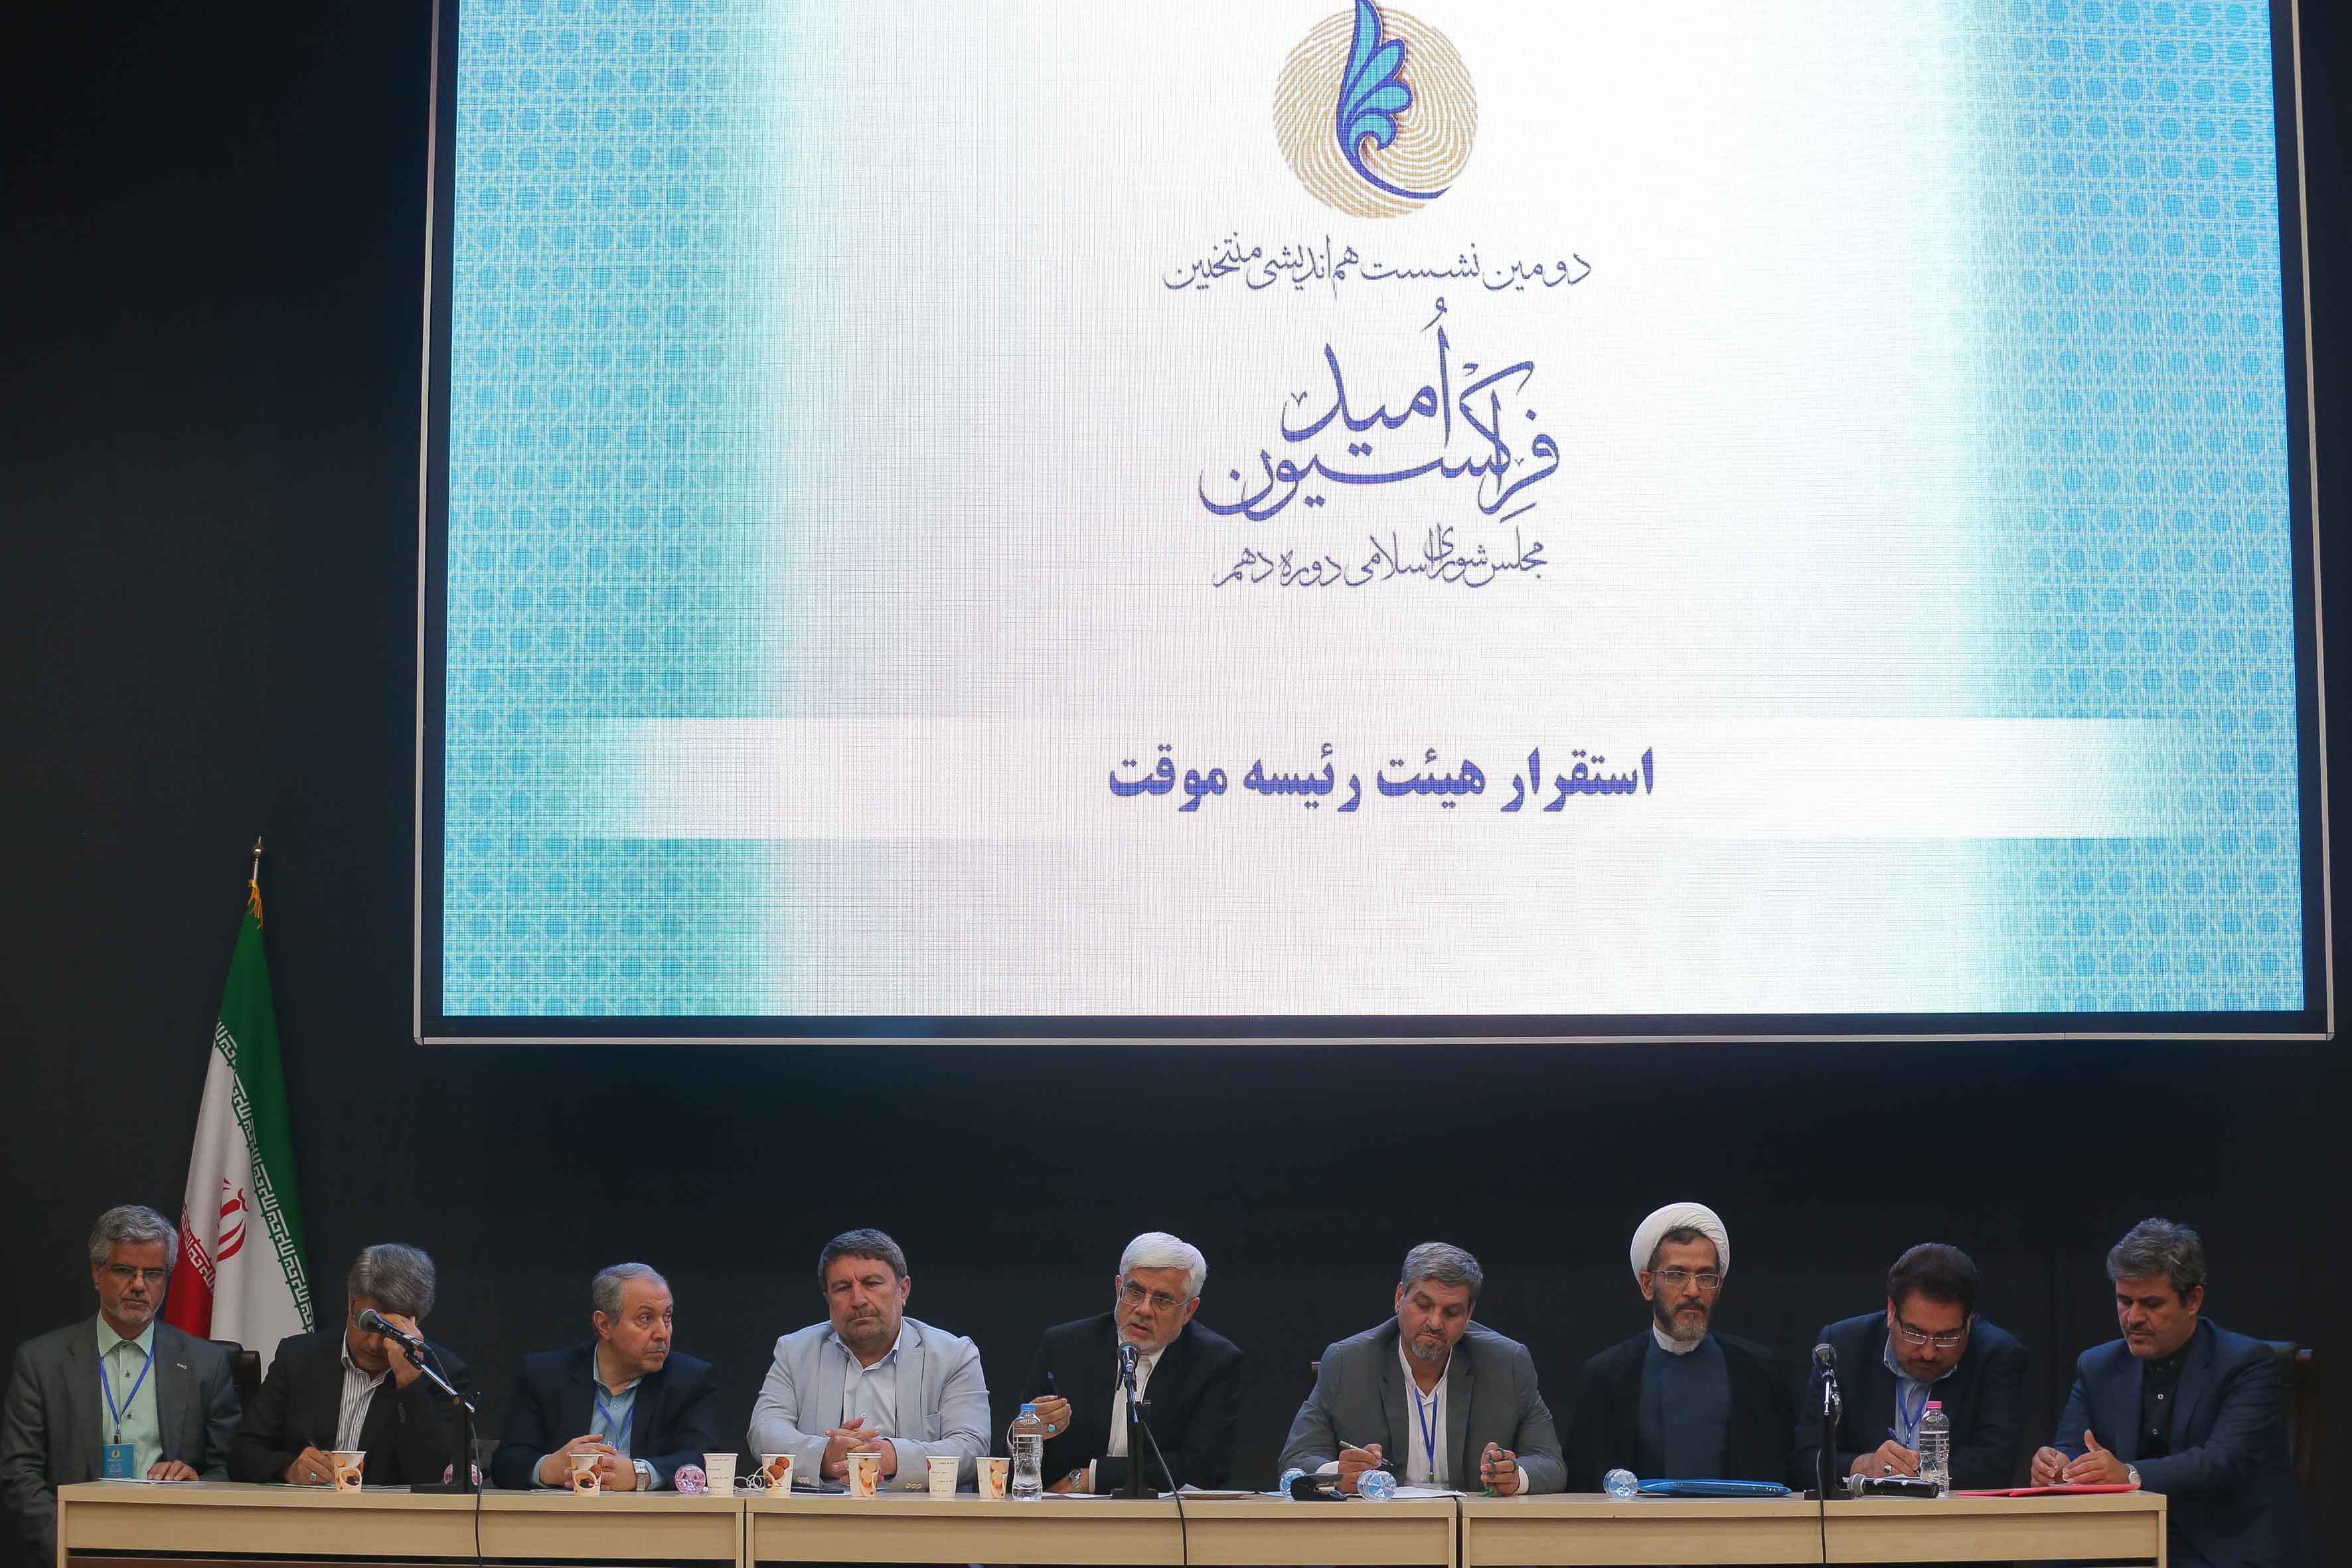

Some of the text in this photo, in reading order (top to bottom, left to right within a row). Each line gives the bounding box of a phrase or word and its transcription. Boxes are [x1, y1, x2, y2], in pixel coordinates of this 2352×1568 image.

[1162, 232, 1261, 290] منتخبین
[1360, 242, 1480, 281] نشست
[1482, 253, 1592, 291] دومین
[1213, 548, 1273, 588] دهم
[1344, 526, 1435, 588] اسلامی
[1464, 525, 1547, 588] مجلس
[1109, 742, 1654, 813] استقرار هیئت رئیسه موقت
